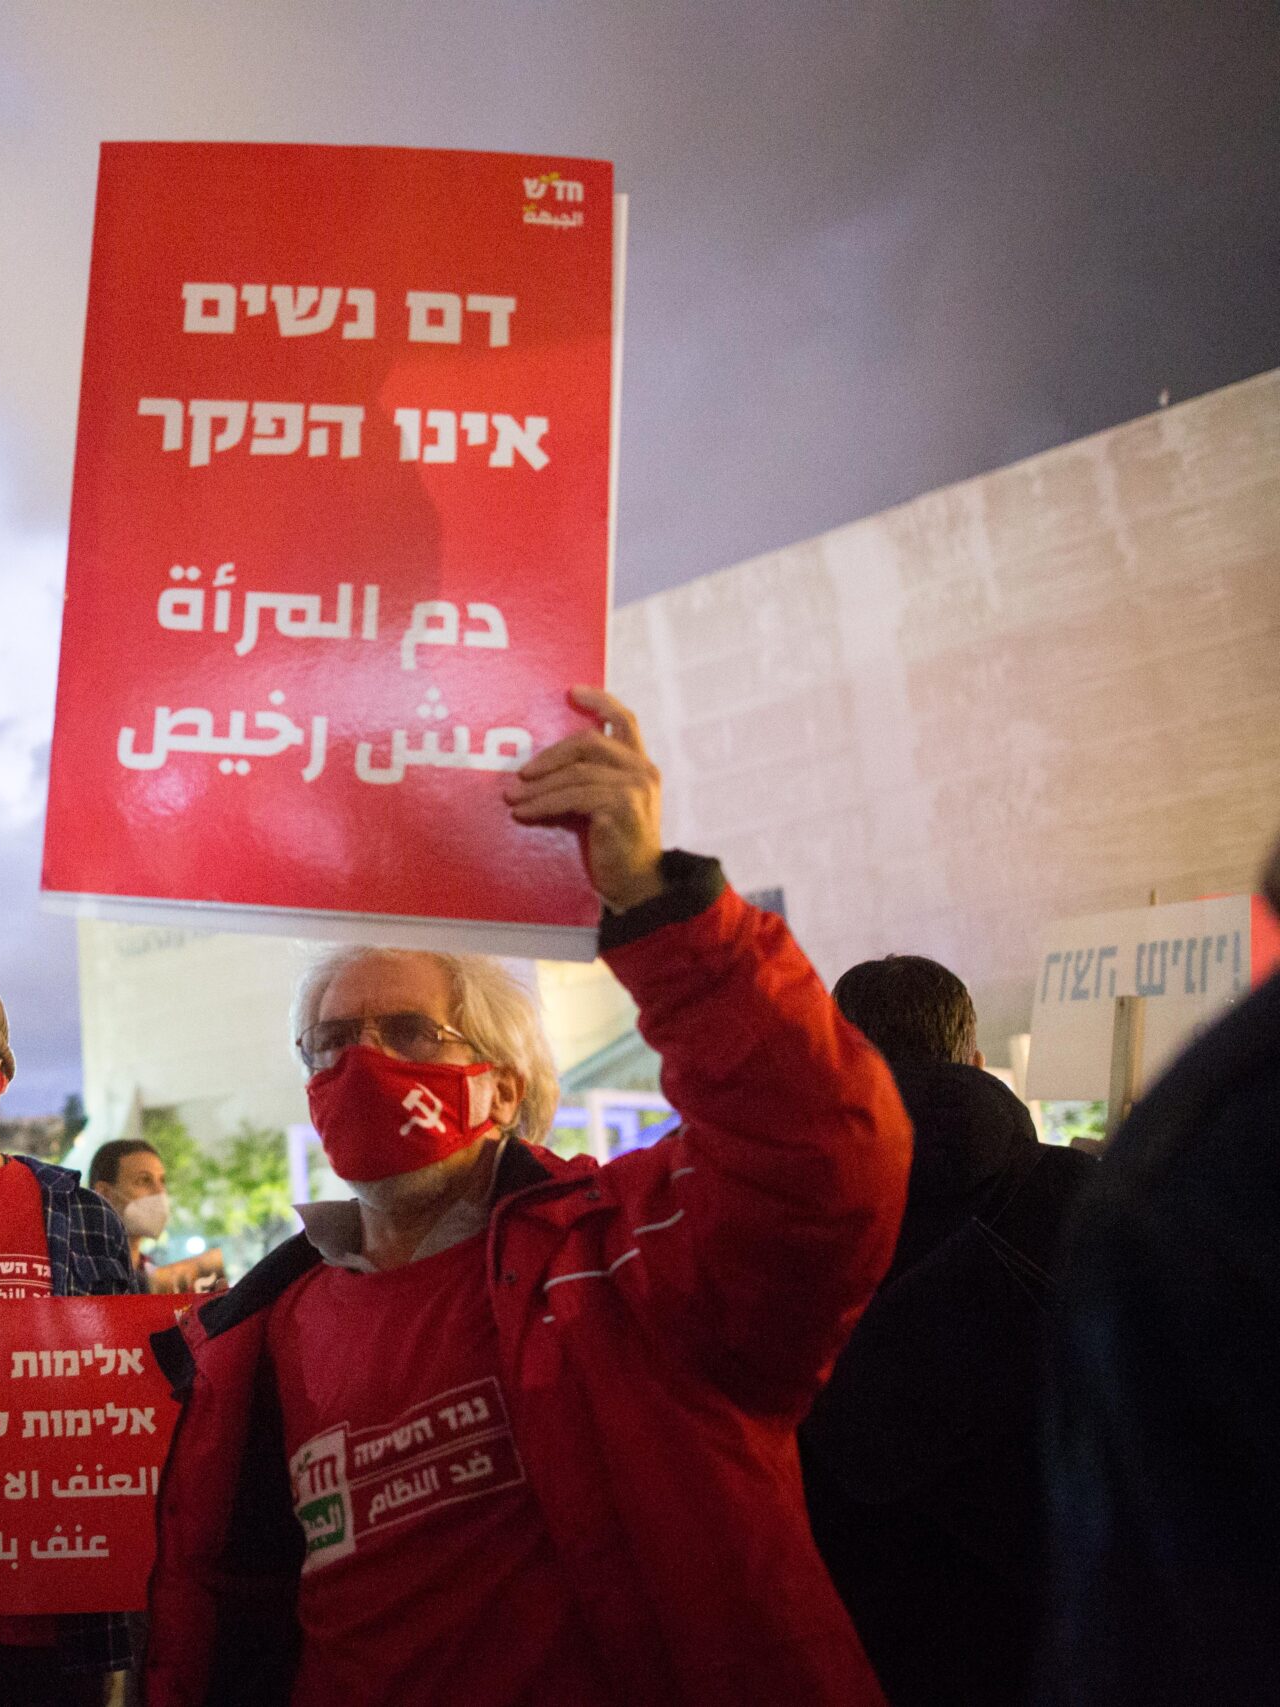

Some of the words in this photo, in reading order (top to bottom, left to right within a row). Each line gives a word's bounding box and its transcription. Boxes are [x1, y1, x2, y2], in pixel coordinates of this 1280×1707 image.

[182, 282, 377, 340] נשים
[406, 289, 517, 348] דם
[137, 396, 366, 467] הפקר
[394, 407, 551, 471] אינו
[157, 562, 380, 657] المرأة
[400, 599, 509, 670] دم
[117, 688, 329, 783] رخيص
[354, 686, 534, 785] مش
[33, 1263, 52, 1279] גד
[11, 1343, 144, 1380] אלימות
[22, 1402, 157, 1439] אלימות
[354, 1416, 435, 1467] השיטה
[438, 1396, 490, 1431] נגד
[51, 1464, 158, 1498] العنف
[369, 1465, 440, 1524] النظام
[450, 1450, 494, 1484] ضد
[30, 1524, 110, 1560] عنف
